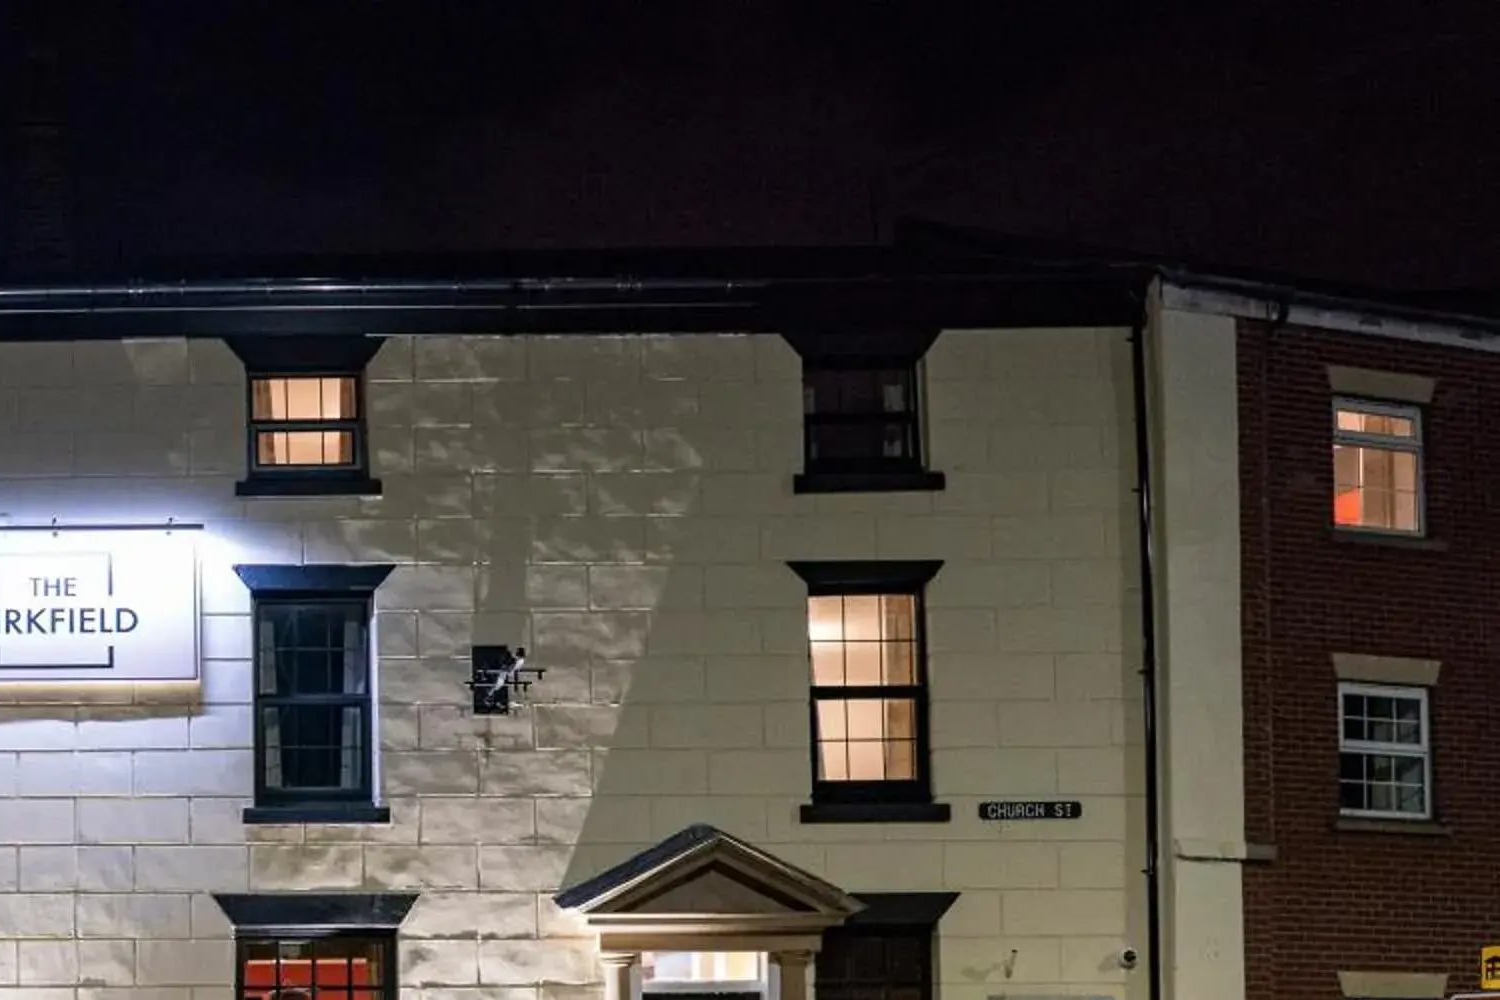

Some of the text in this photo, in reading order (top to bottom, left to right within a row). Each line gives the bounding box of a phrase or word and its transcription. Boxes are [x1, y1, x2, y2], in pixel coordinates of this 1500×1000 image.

[29, 577, 77, 597] THE
[987, 803, 1072, 818] CHURCH ST
